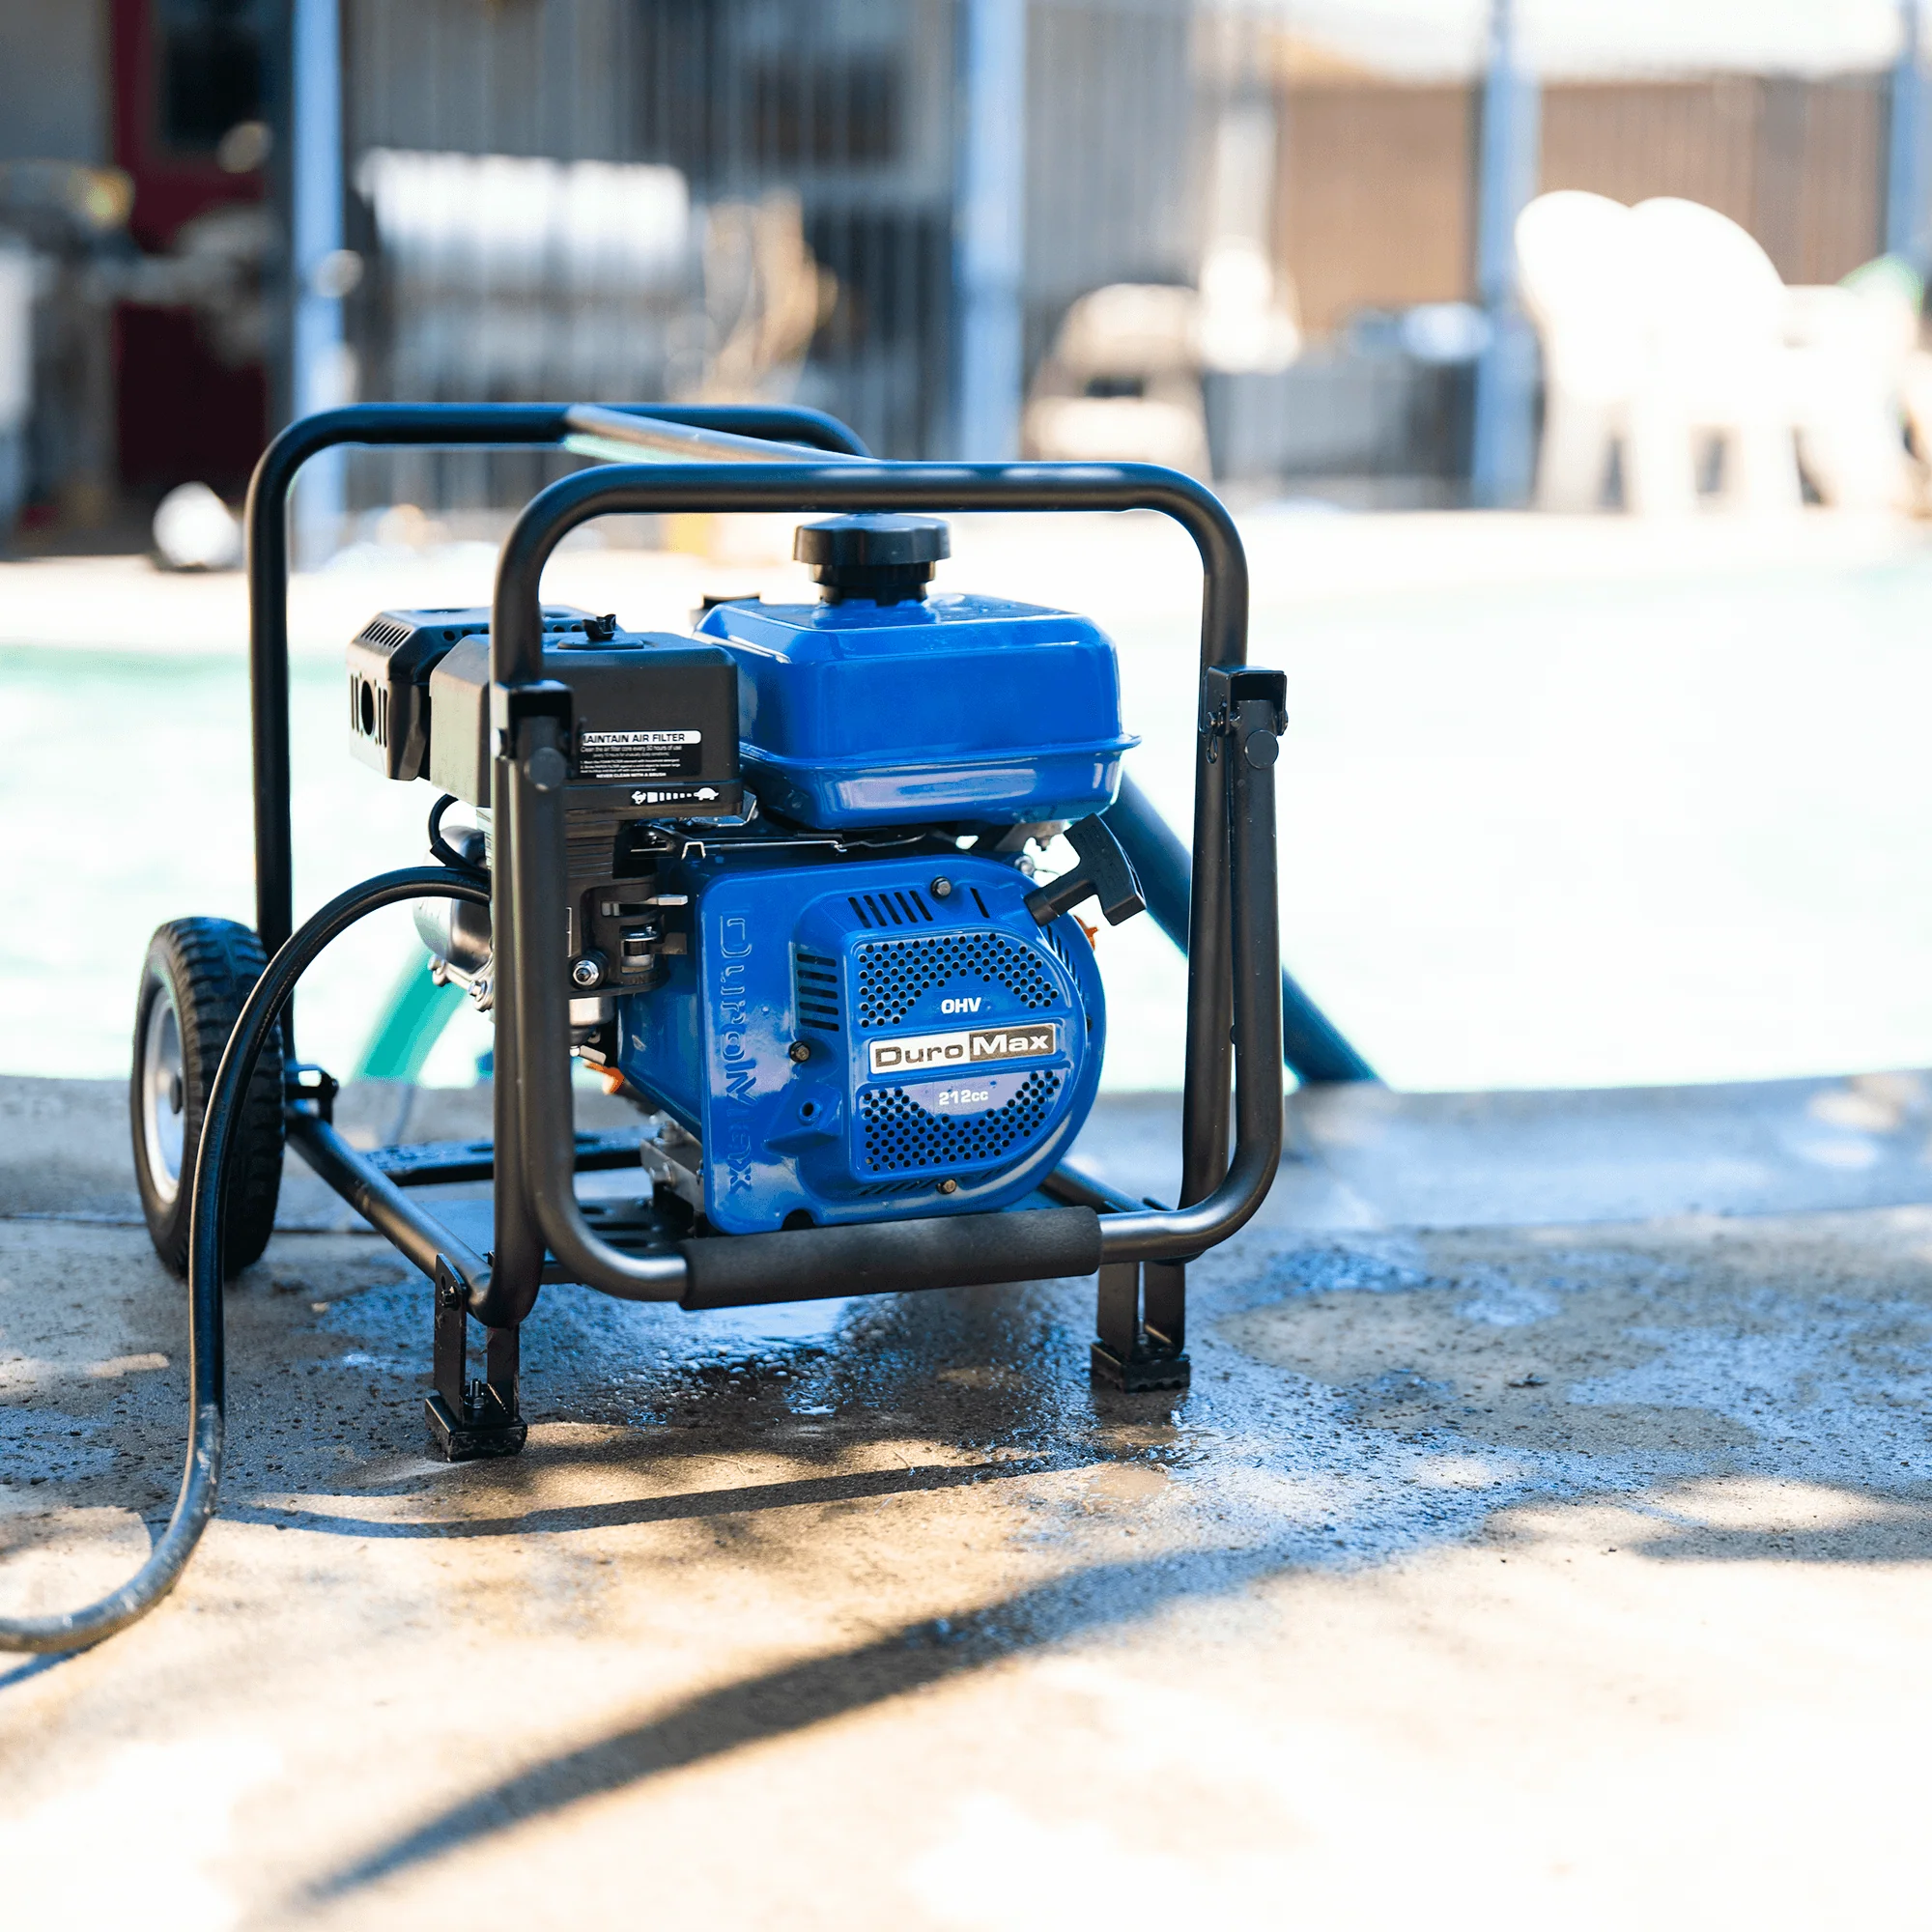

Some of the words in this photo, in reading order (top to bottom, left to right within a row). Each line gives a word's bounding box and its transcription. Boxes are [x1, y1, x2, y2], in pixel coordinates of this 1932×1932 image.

[653, 733, 685, 742] FILTER
[941, 997, 981, 1014] OHV
[939, 1089, 989, 1106] 212cc
